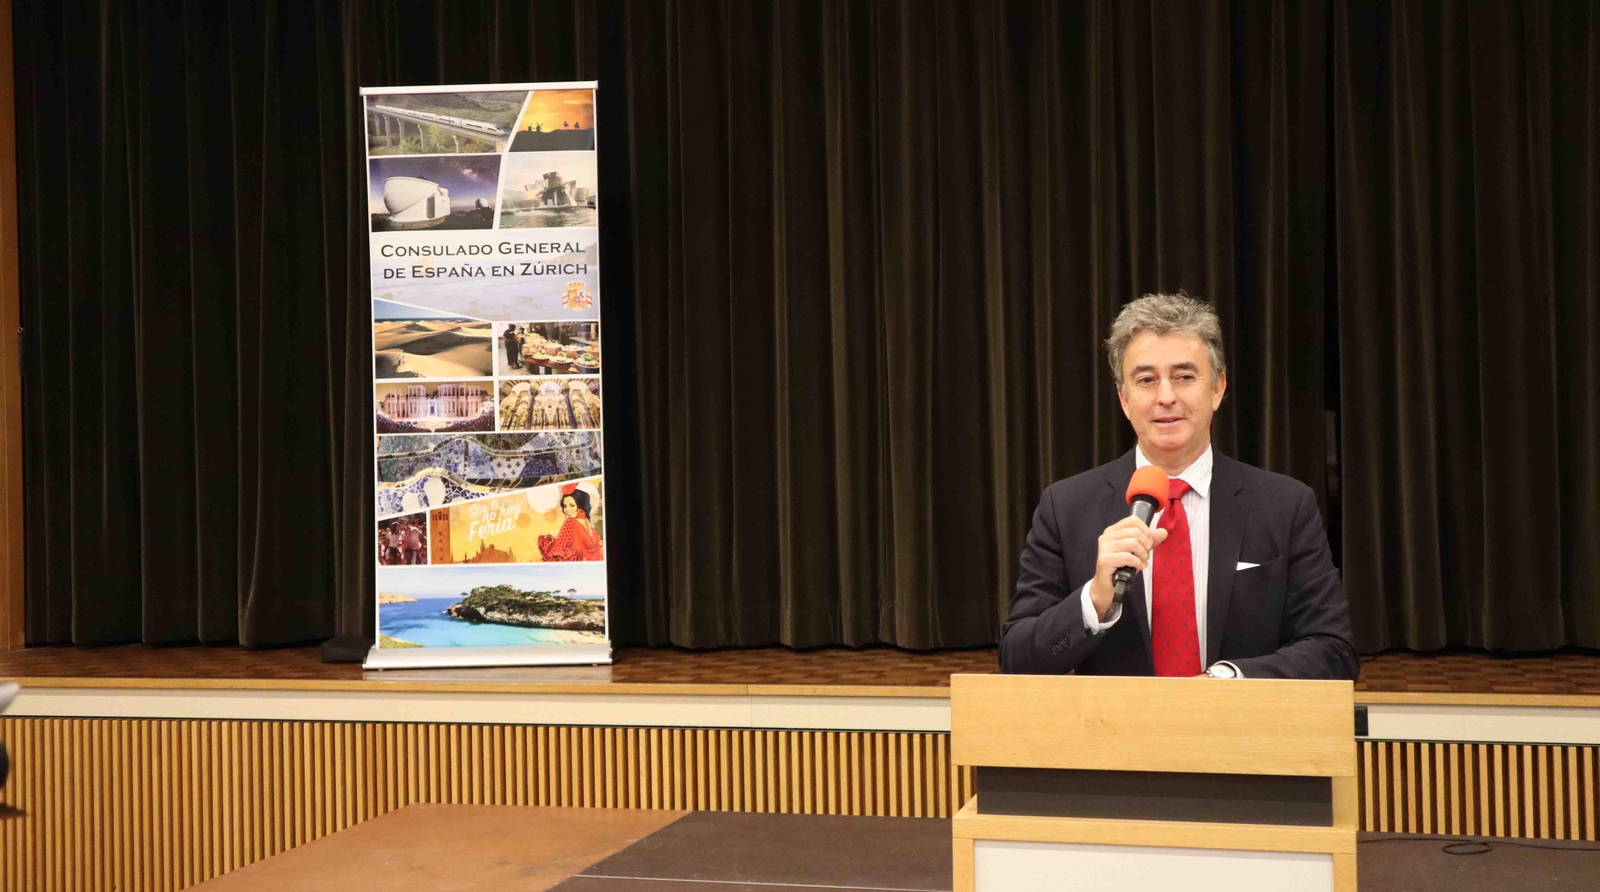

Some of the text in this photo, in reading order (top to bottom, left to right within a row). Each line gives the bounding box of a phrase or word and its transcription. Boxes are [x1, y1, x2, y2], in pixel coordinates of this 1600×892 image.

[381, 241, 586, 257] CONSULADO GENERAL
[383, 261, 588, 279] DE ESPAÑA EN ZÚRICH
[468, 498, 499, 518] Sin ti
[482, 503, 521, 522] no hay
[468, 517, 516, 542] Feria
